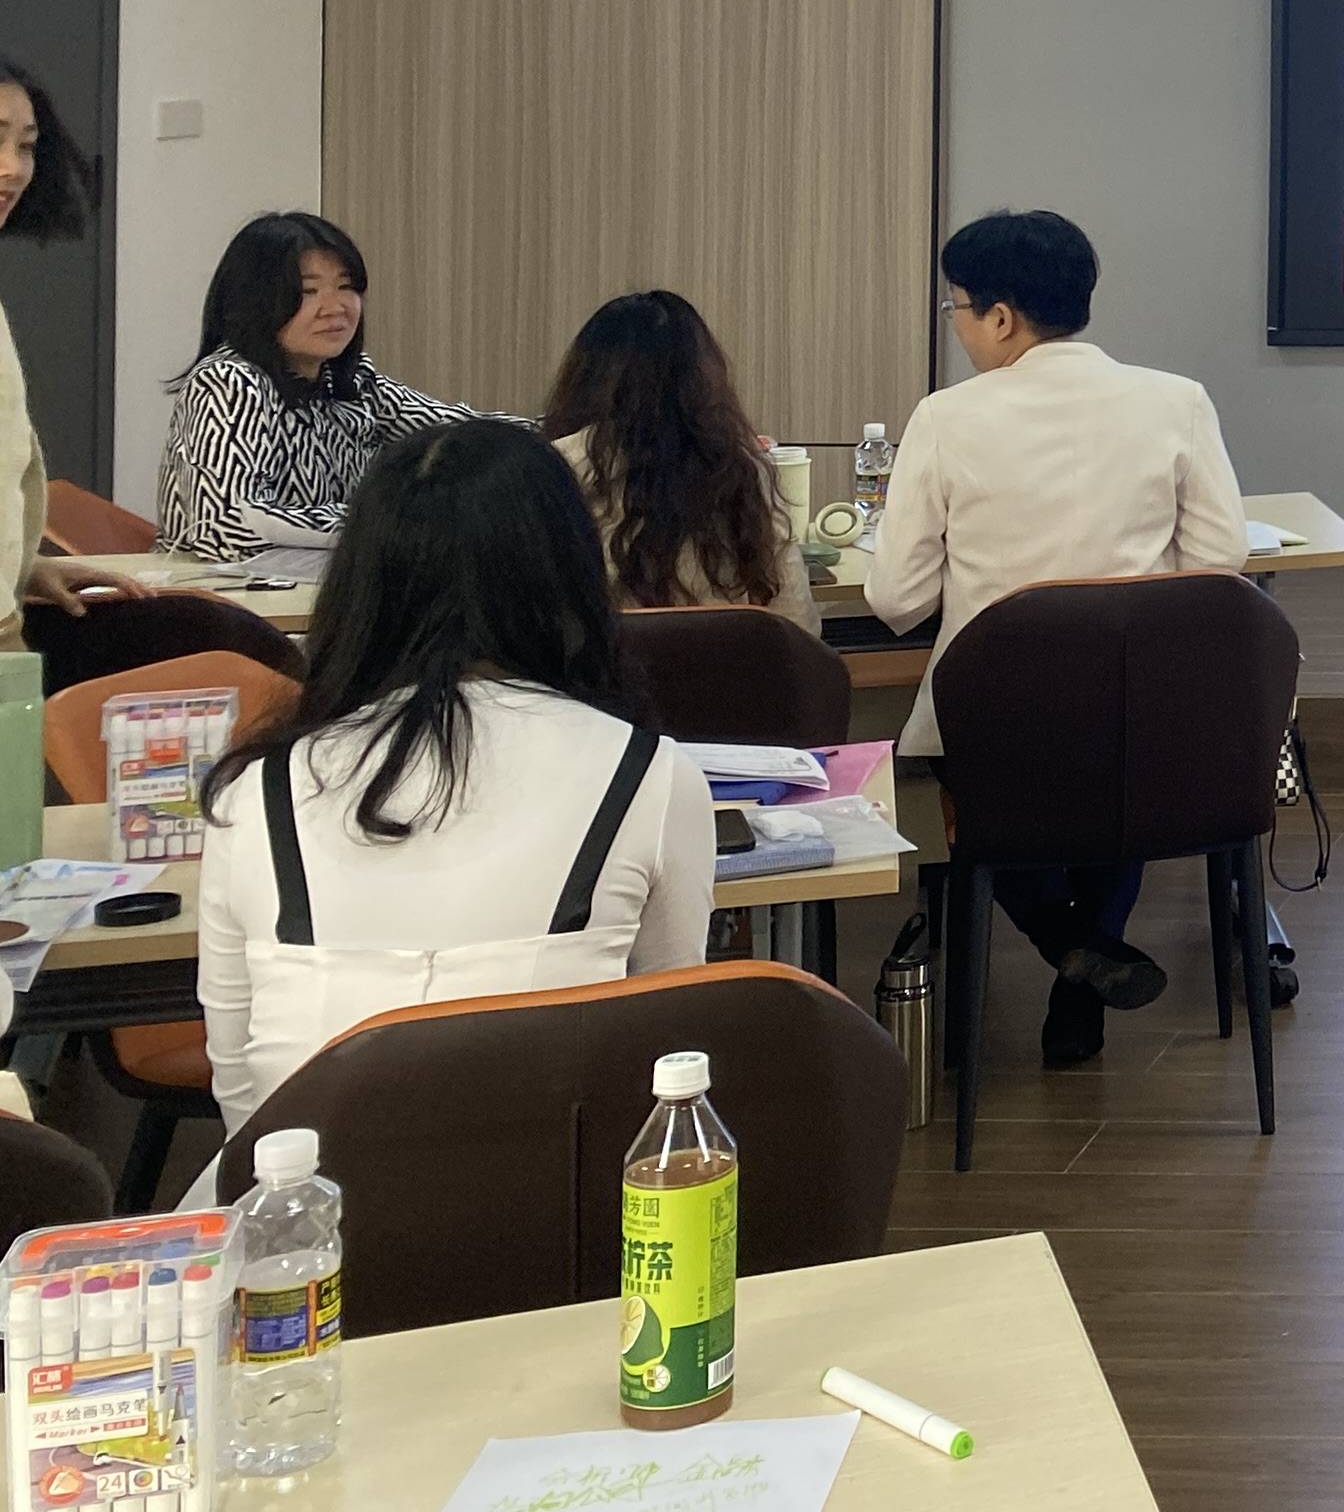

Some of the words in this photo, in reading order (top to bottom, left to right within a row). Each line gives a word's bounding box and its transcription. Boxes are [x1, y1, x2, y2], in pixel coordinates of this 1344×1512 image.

[32, 1398, 147, 1425] 双头绘画马克笔
[99, 1474, 122, 1492] 24
